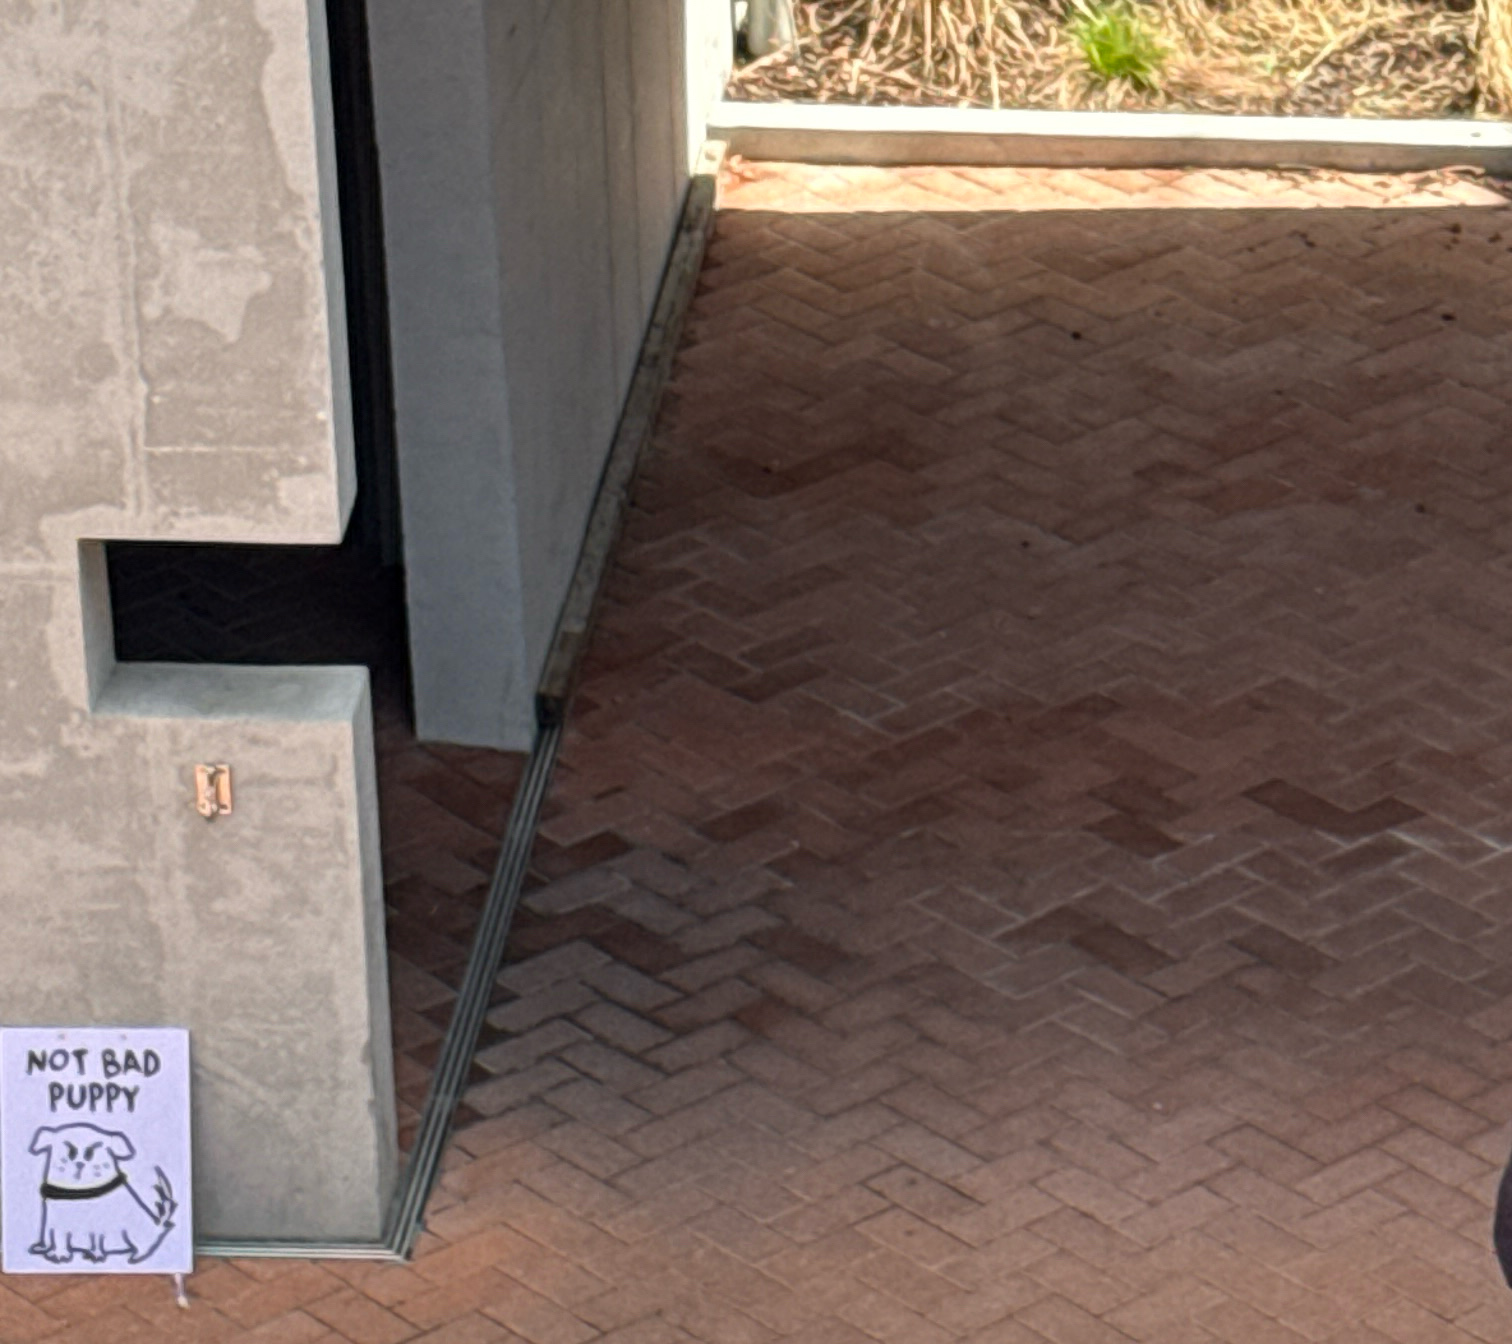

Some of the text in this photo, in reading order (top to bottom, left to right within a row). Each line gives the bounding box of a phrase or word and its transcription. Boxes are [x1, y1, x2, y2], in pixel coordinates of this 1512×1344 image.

[26, 1048, 161, 1078] NOT BAD
[48, 1081, 140, 1112] PUPPY
